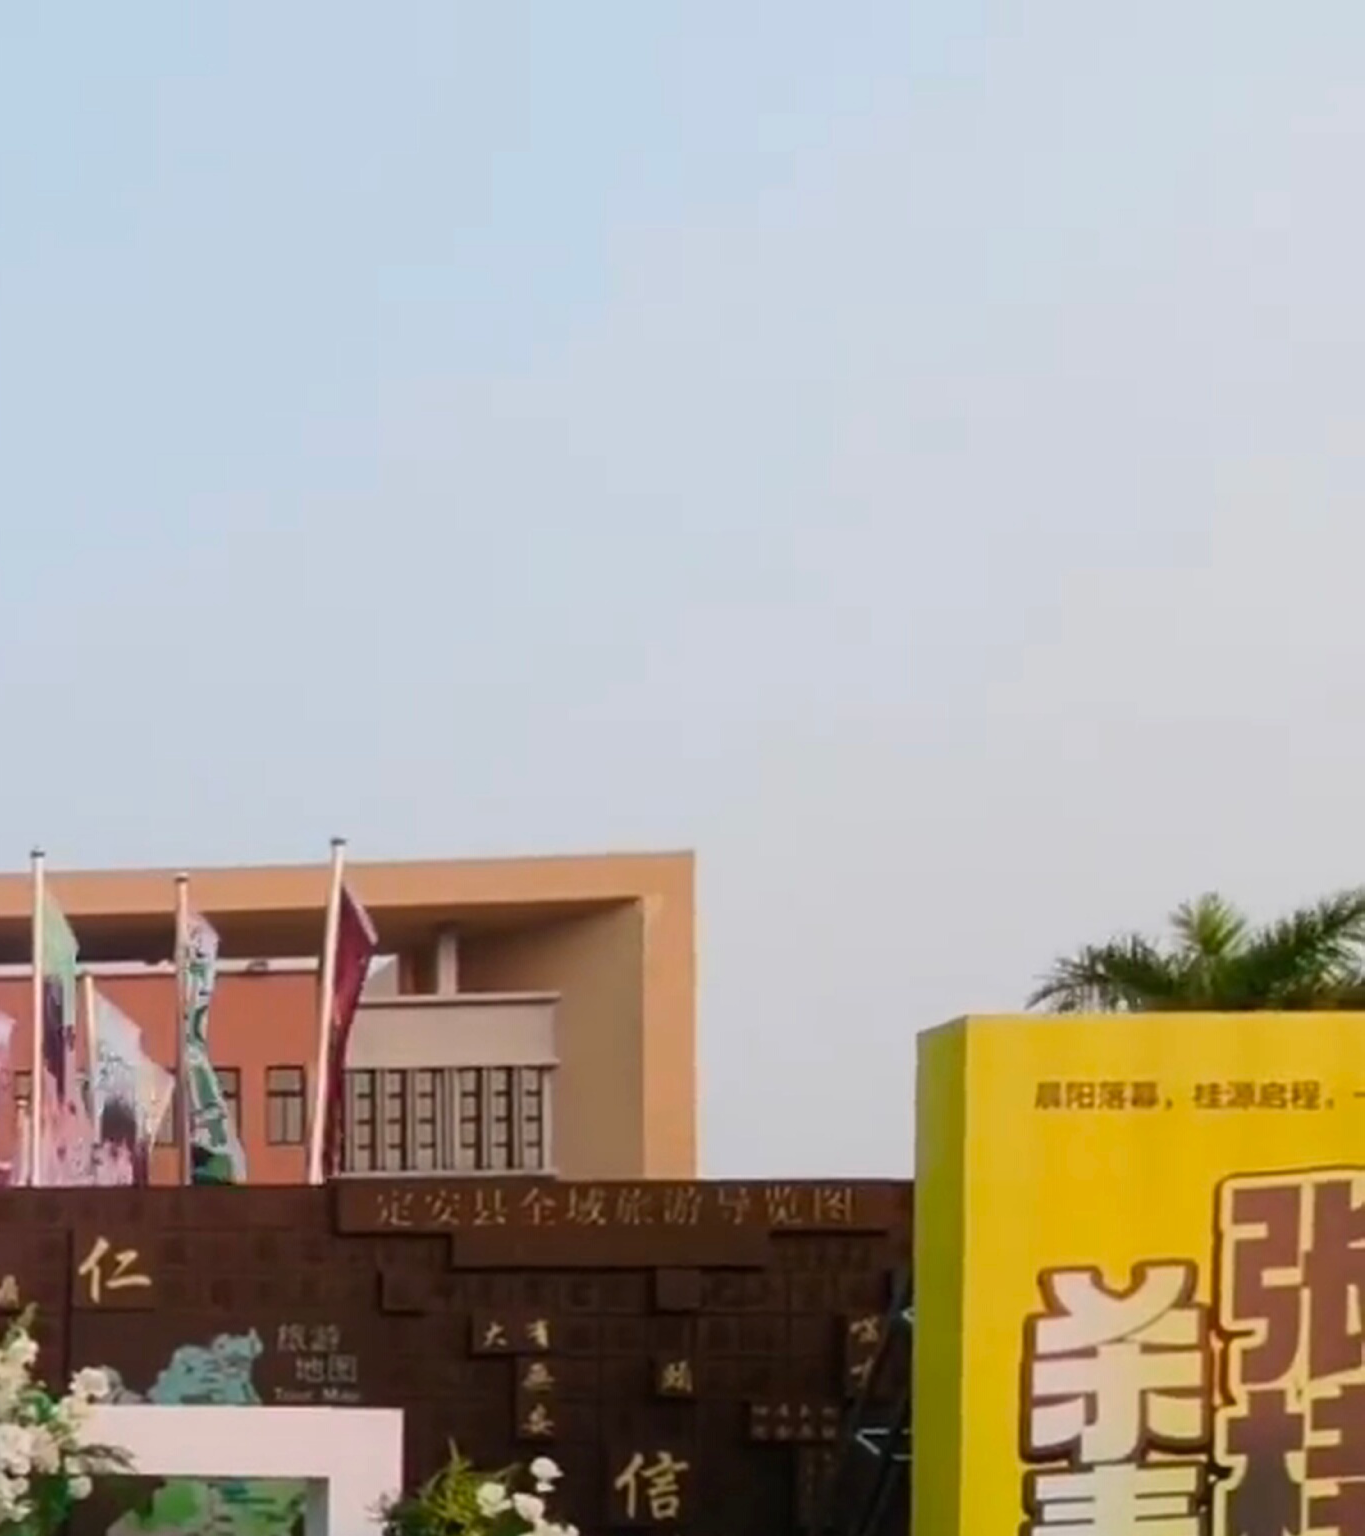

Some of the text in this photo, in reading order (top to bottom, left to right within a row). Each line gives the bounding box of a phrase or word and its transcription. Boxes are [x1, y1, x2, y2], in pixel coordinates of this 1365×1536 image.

[375, 1185, 855, 1228] 定安县全域旅游导览图
[79, 1236, 152, 1304] 仁
[614, 1450, 690, 1519] 信
